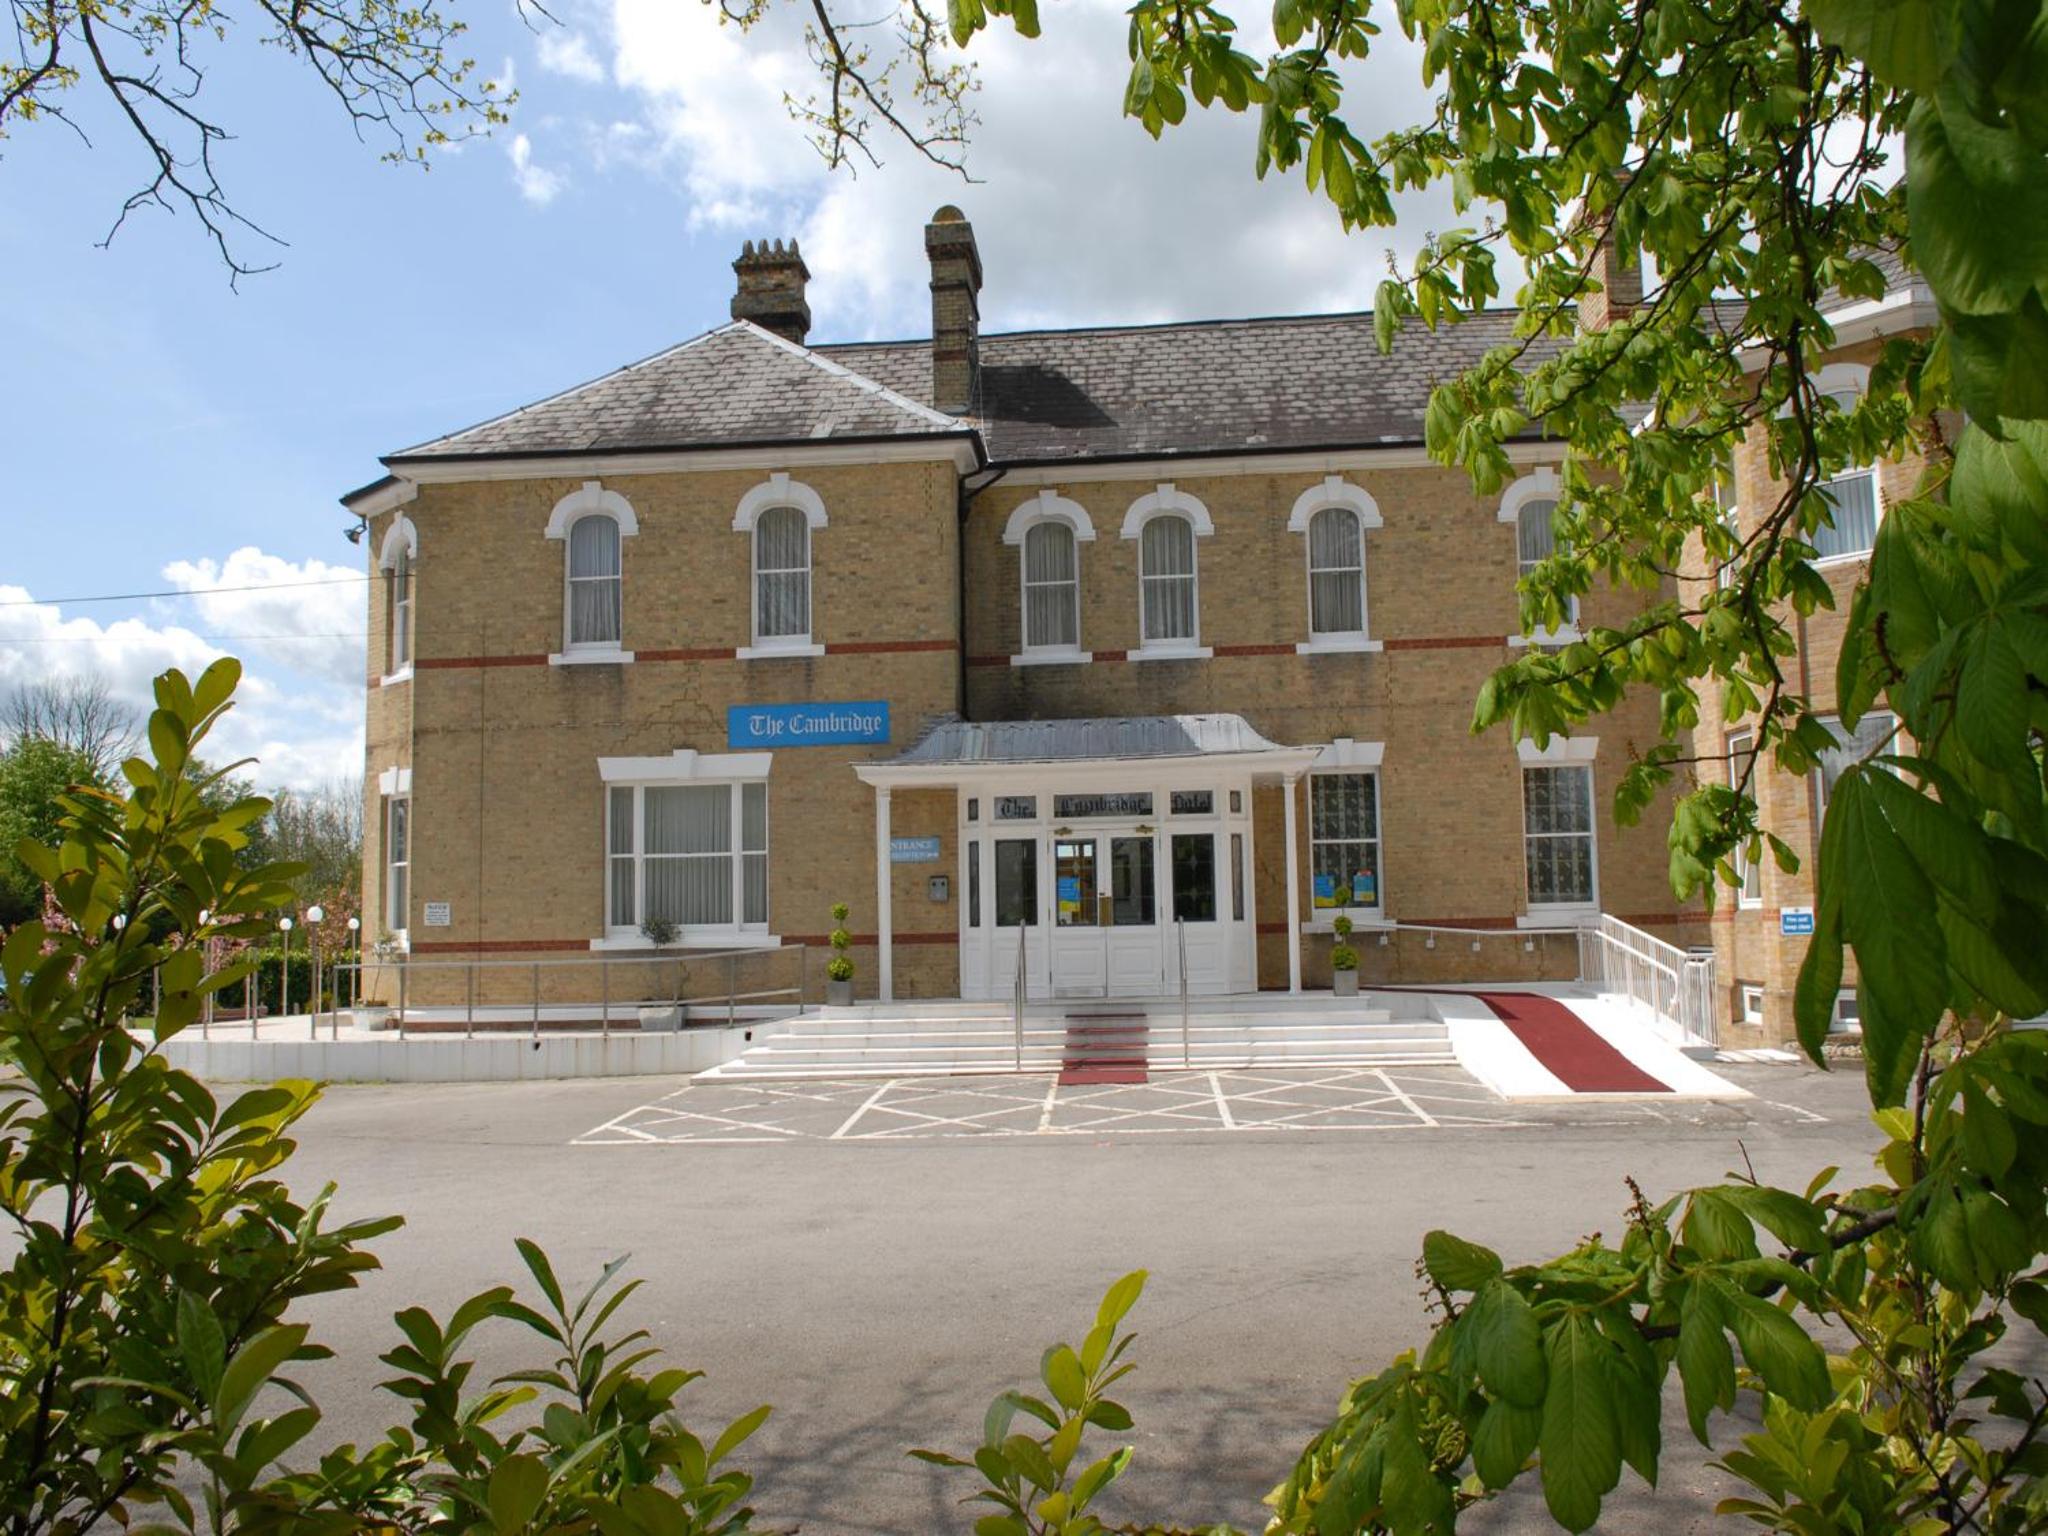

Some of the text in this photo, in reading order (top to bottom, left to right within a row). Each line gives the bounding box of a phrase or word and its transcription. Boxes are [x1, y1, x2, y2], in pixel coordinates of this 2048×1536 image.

[749, 712, 882, 737] The Cambridge
[1001, 798, 1030, 818] The
[889, 840, 930, 849] NTRANCE
